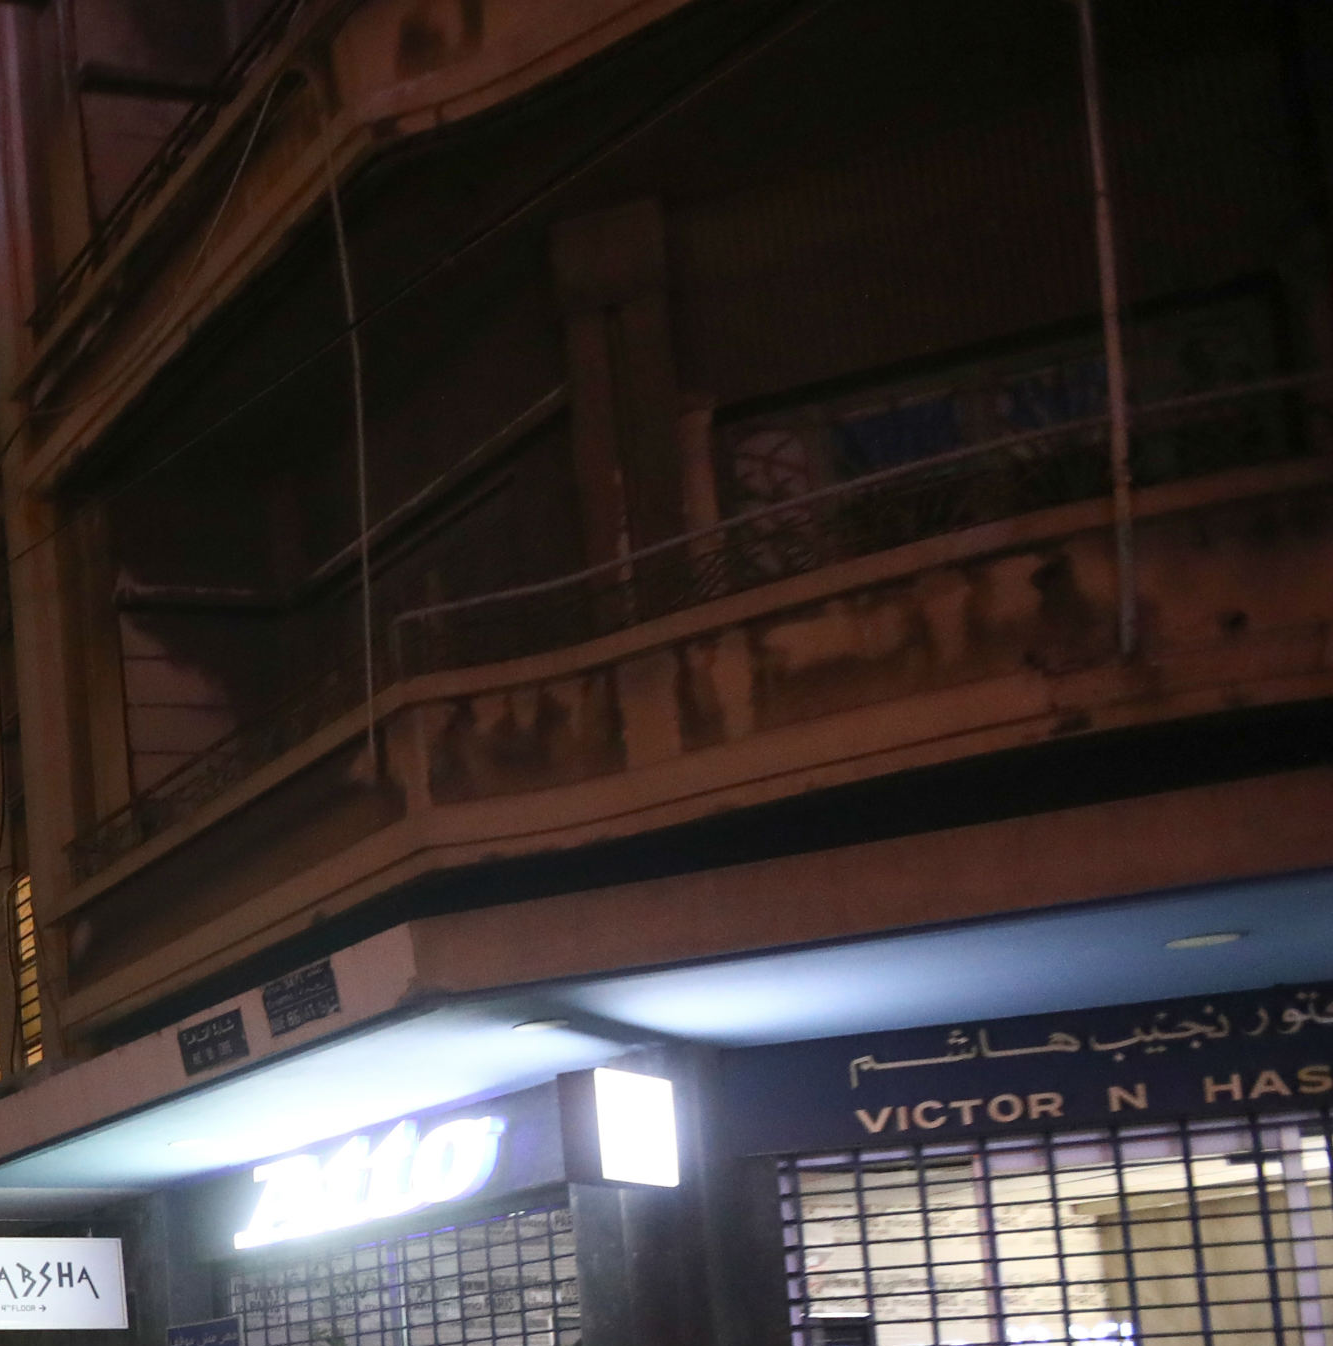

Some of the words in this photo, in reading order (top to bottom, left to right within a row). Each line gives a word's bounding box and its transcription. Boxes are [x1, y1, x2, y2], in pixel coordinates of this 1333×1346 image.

[849, 1027, 1082, 1090] هاشم
[1089, 1003, 1231, 1063] نجيب
[854, 1091, 1065, 1134] VICTOR
[1107, 1082, 1148, 1112] N
